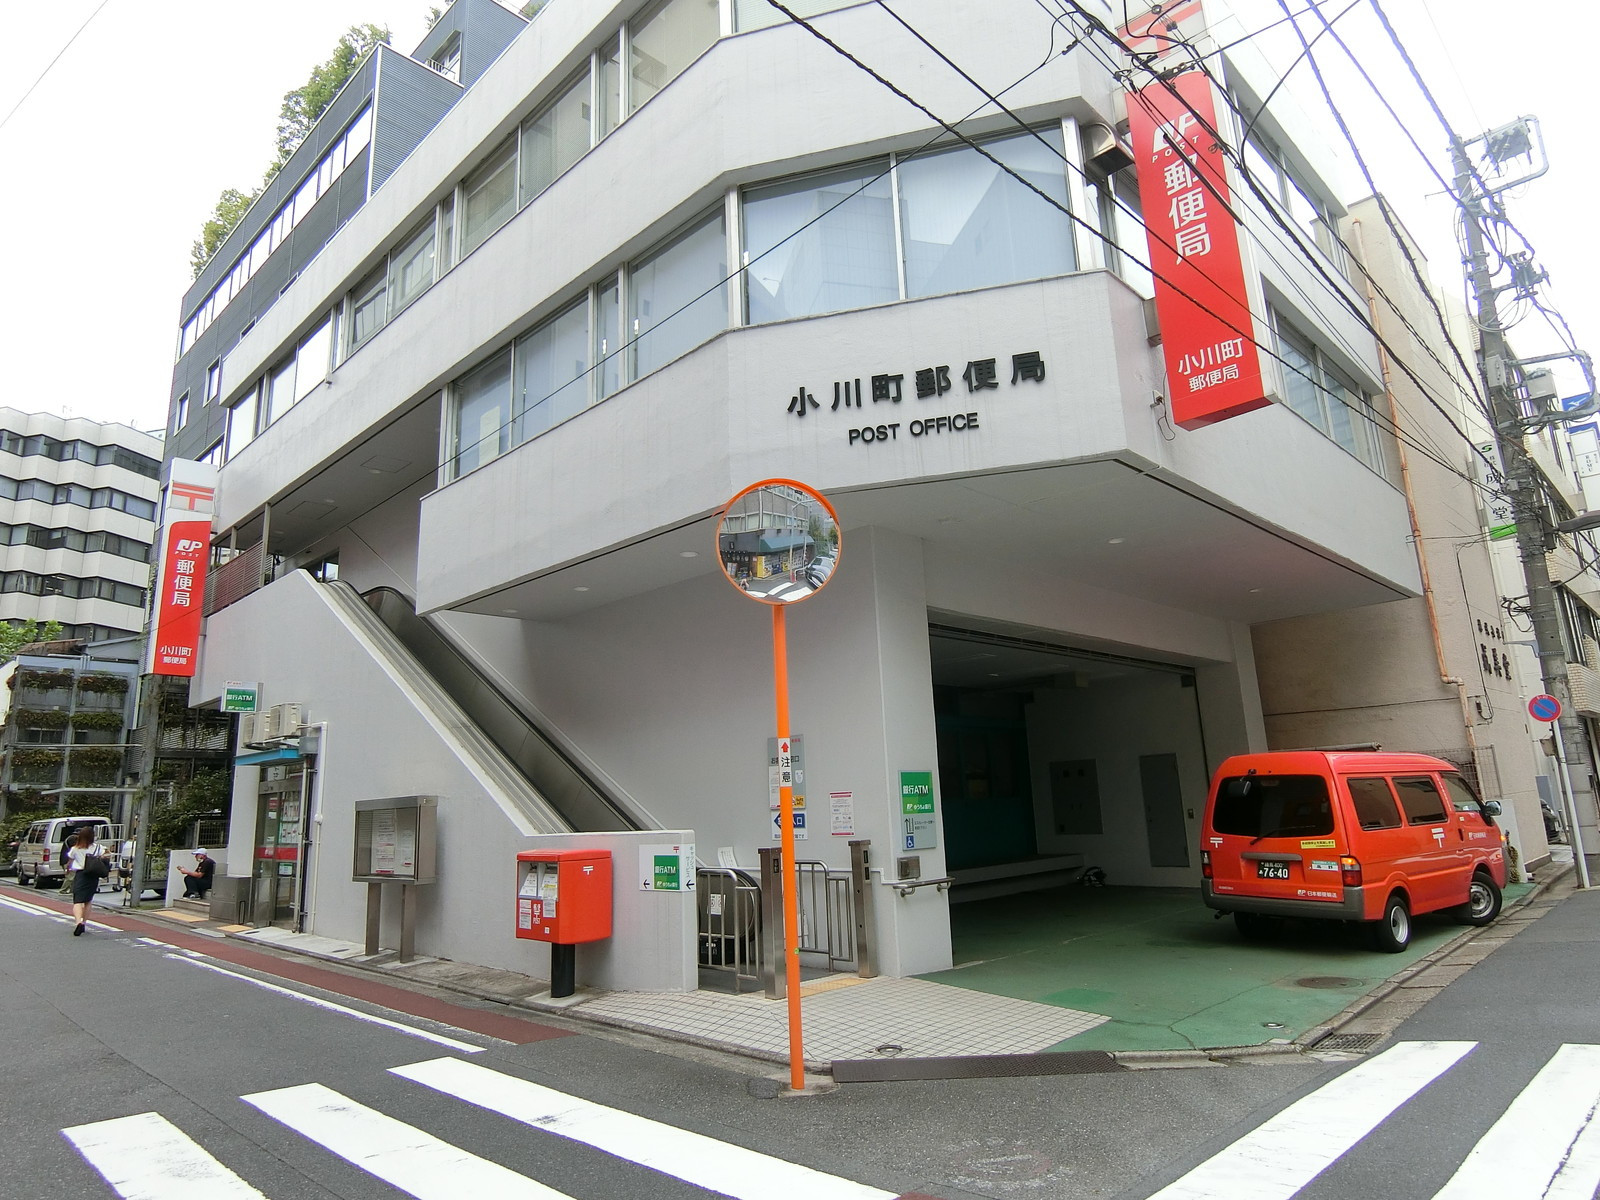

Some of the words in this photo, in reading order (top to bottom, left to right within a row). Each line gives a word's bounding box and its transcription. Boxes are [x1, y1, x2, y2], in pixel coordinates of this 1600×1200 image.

[1152, 135, 1199, 164] POST
[1163, 152, 1211, 265] 郵便局
[1178, 337, 1243, 376] 小川町
[787, 350, 1046, 417] 小川町郵便局
[1188, 363, 1239, 393] 郵便局
[849, 423, 900, 446] POST
[909, 412, 980, 437] OFFICE
[171, 559, 195, 607] 郵便局
[160, 645, 192, 657] 小川町
[162, 656, 187, 665] 郵便局
[781, 756, 791, 782] 注意
[903, 785, 929, 795] 銀行ATM
[654, 865, 676, 874] 銀行ATM
[1263, 867, 1289, 879] 76-40
